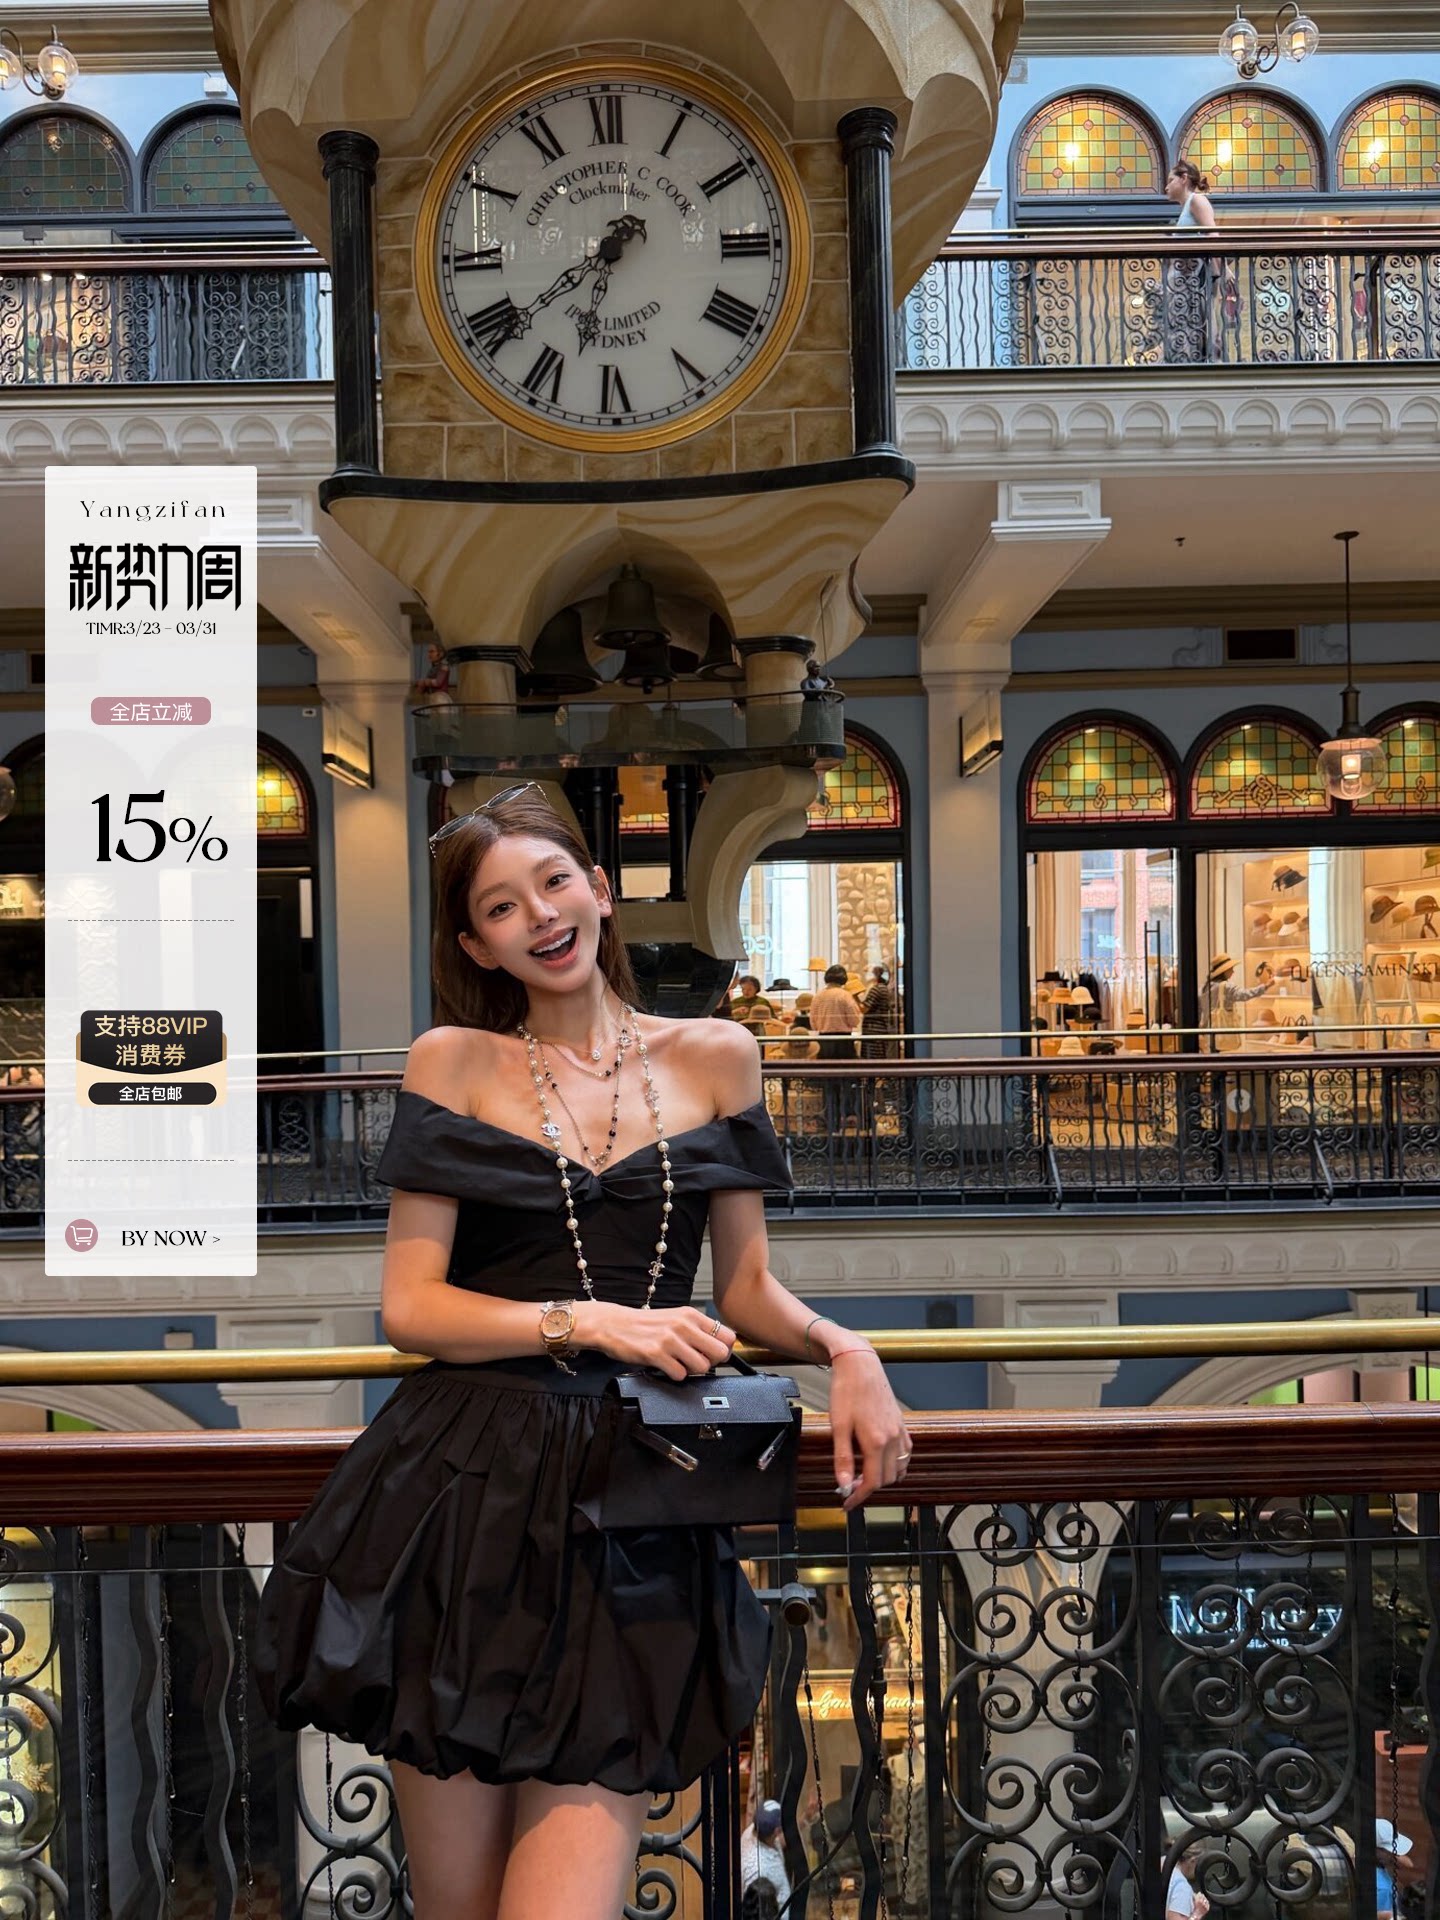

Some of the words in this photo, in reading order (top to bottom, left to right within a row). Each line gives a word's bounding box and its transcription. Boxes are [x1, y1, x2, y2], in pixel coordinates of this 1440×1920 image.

[583, 95, 629, 147] XII
[526, 160, 628, 227] CHRISTOPHER
[637, 166, 650, 181] C
[656, 176, 694, 218] COOK
[568, 180, 650, 206] Clockmaker
[604, 301, 661, 331] LIMITED
[585, 328, 647, 349] YDNEY
